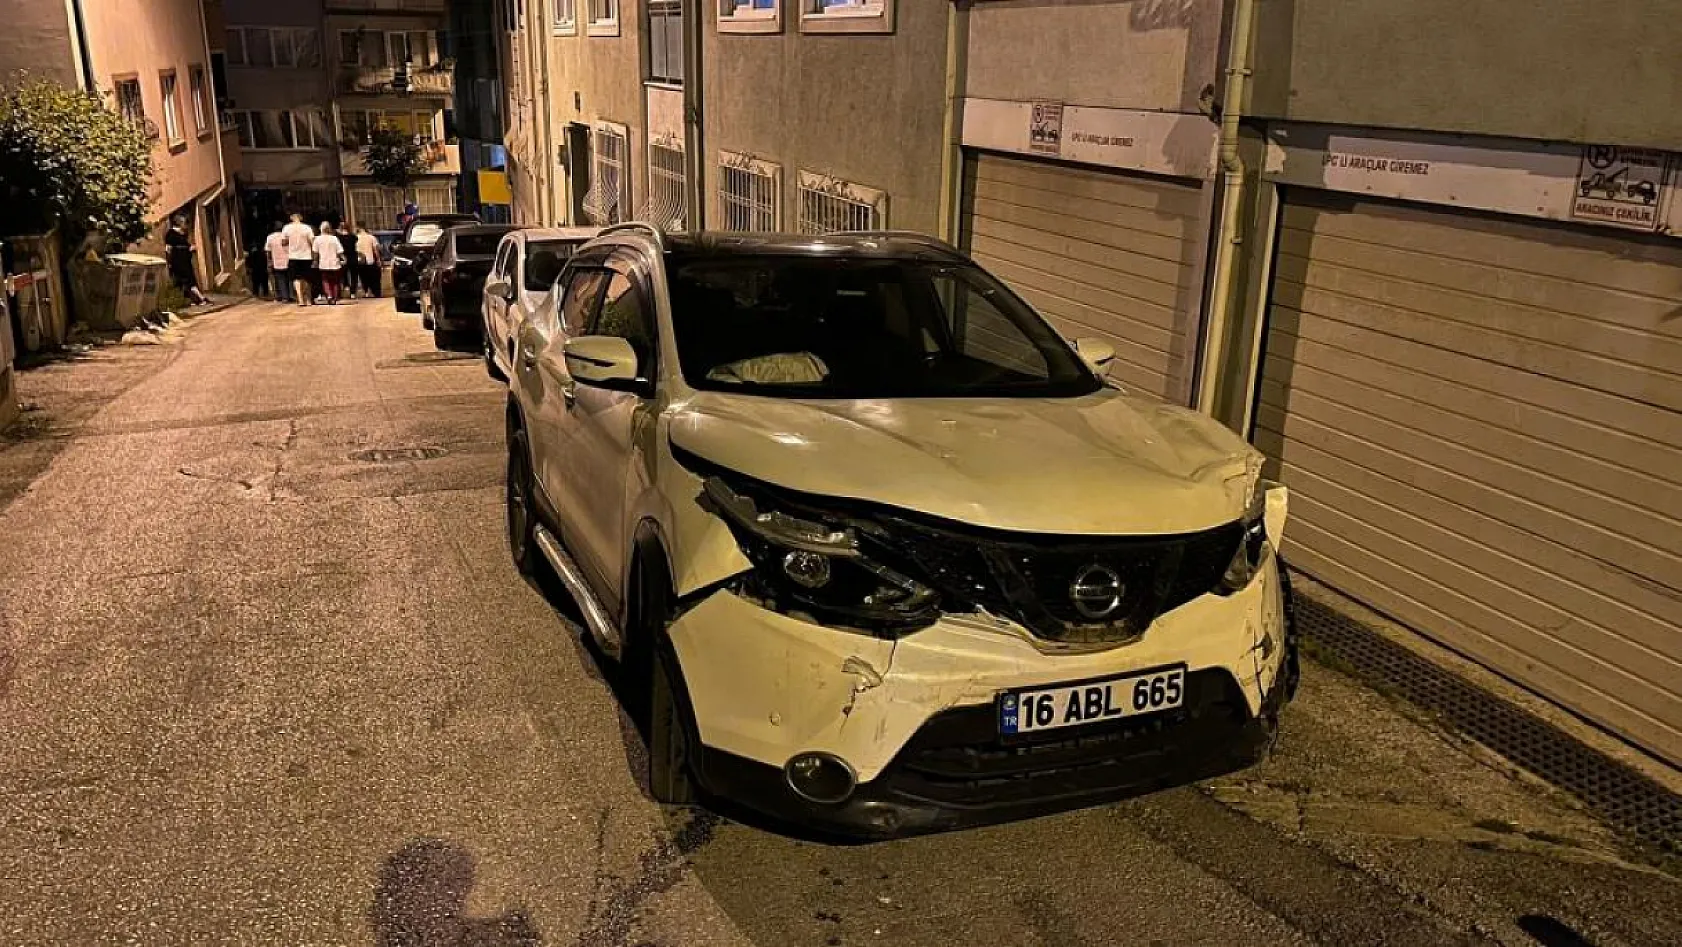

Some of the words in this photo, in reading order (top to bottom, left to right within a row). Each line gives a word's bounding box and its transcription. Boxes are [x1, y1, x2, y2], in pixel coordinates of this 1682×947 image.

[1021, 693, 1055, 729] 16
[1063, 685, 1122, 723] ABL
[1133, 672, 1182, 711] 665
[1003, 715, 1017, 727] TR
